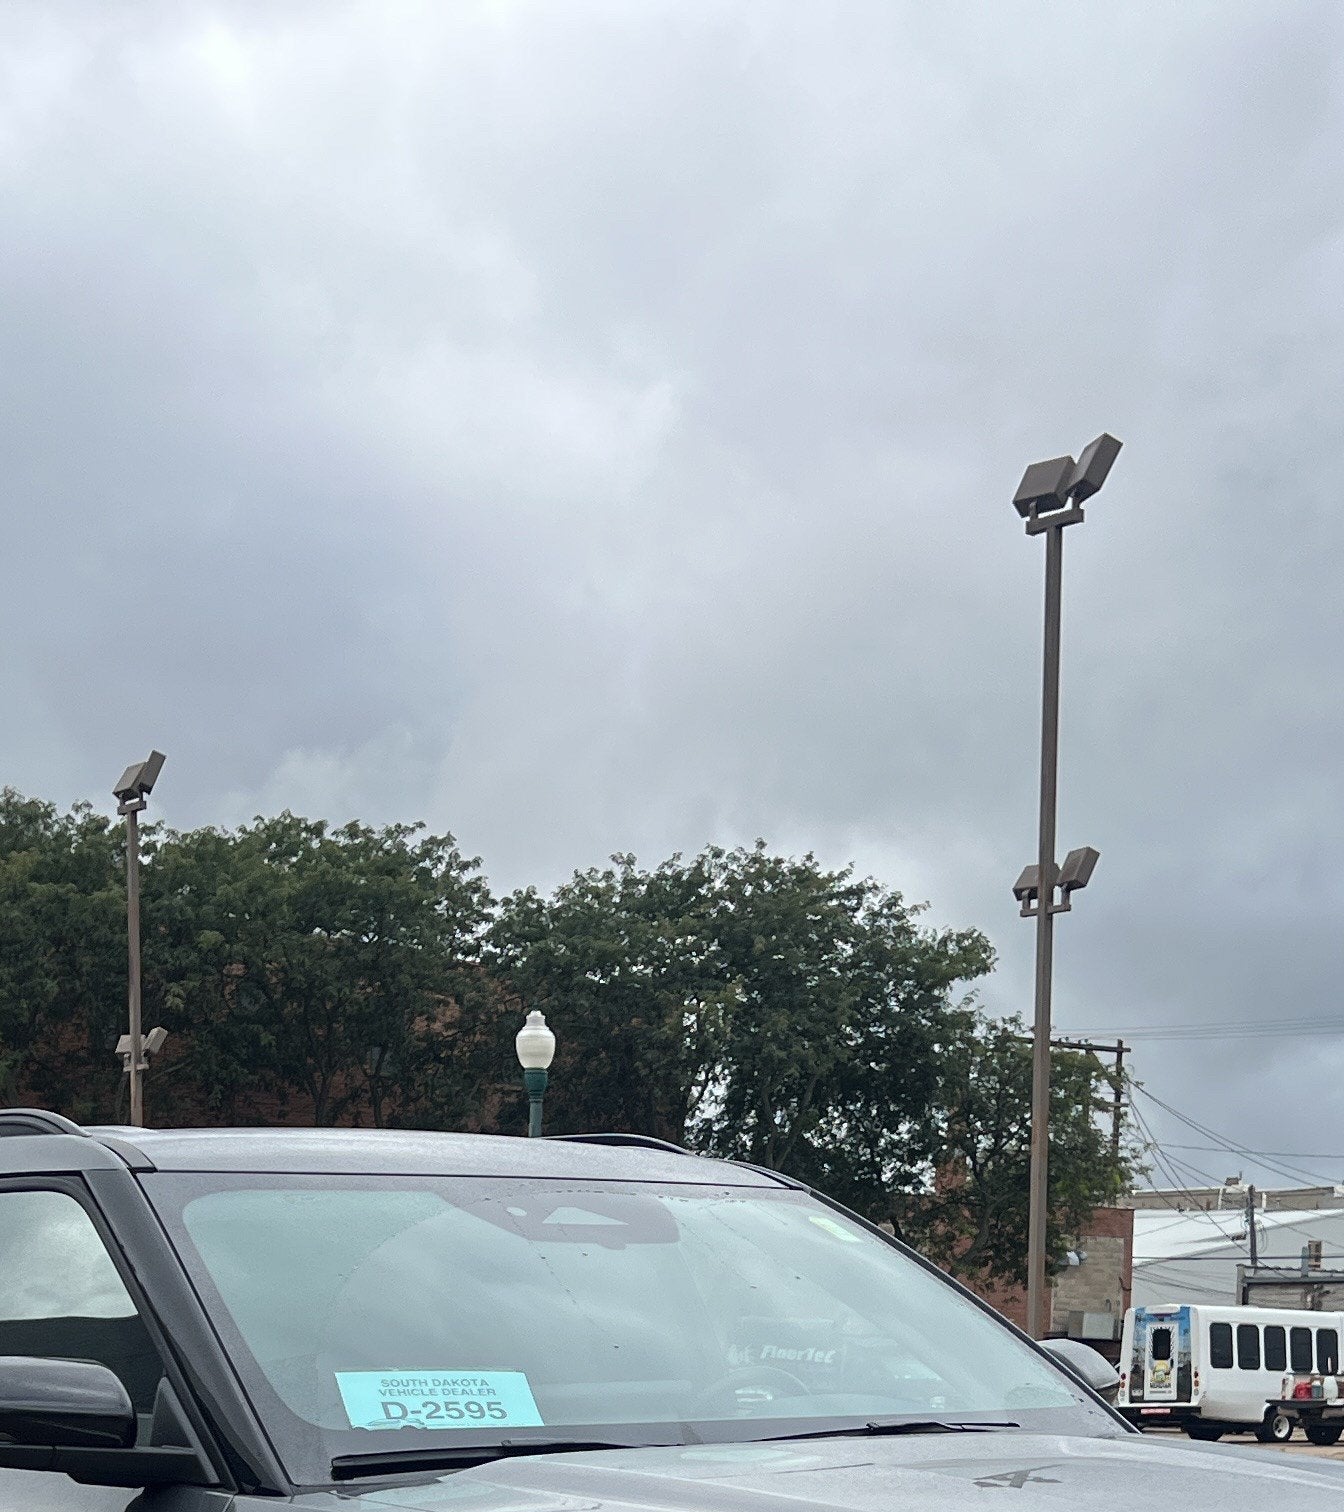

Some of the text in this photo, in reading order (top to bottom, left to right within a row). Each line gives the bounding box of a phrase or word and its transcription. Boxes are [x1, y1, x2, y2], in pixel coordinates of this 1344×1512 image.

[381, 1378, 490, 1388] SOUTH DAKOTA
[378, 1388, 497, 1397] VEHICLE DEALER
[381, 1401, 508, 1420] D-2595
